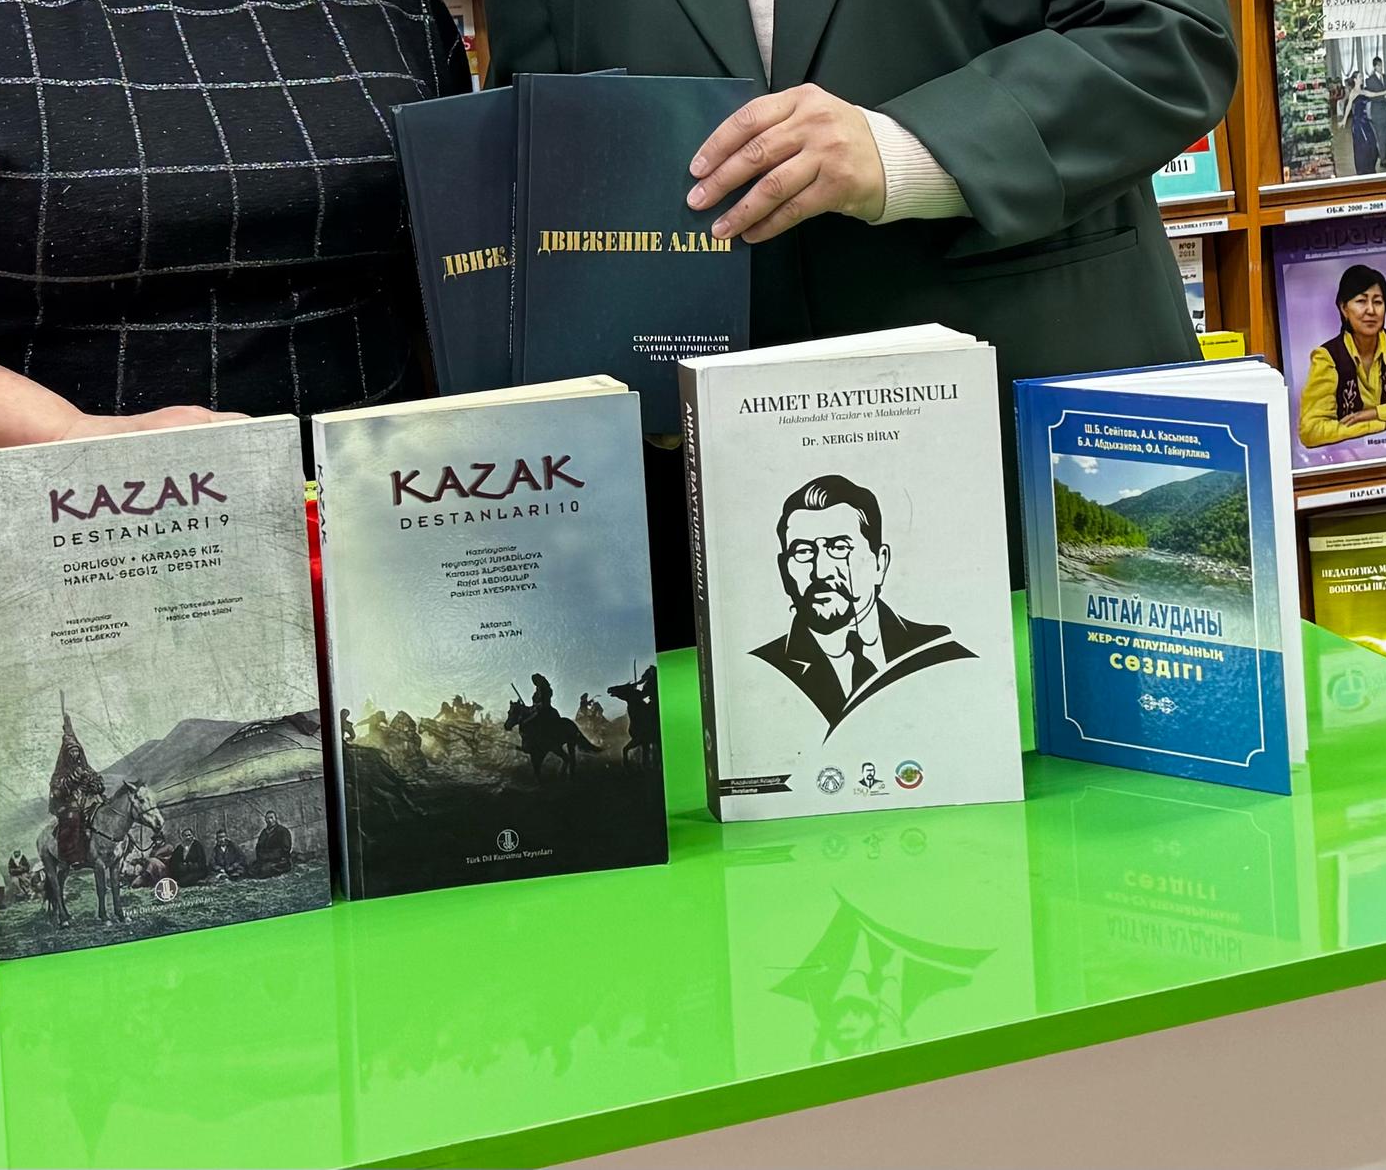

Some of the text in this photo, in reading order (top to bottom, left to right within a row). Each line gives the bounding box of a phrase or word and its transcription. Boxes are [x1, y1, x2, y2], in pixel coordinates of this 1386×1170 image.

[1164, 158, 1189, 173] 2011
[537, 230, 662, 256] ДВИЖЕНИЕ
[739, 384, 958, 414] AHMET BAYTURSINULI
[802, 430, 900, 446] Dr. NERGİS BİRAY
[1077, 437, 1093, 447] Б.А.
[1085, 424, 1157, 440] Ш.Б. А.А.
[390, 455, 585, 506] KAZAK
[1350, 487, 1384, 498] ПАРАСАТ
[49, 472, 227, 523] KAZAK
[400, 500, 580, 531] DESTANLARI 10
[53, 514, 230, 549] DESTANLARI 9
[168, 558, 222, 572] DESTANI
[1087, 594, 1223, 638] АЛТАЙ АУДАНЫ
[1087, 631, 1224, 663] ЖЕР-СУ АТАУЛАРЫНЫҢ
[1110, 653, 1203, 681] СӨЗДІГІ
